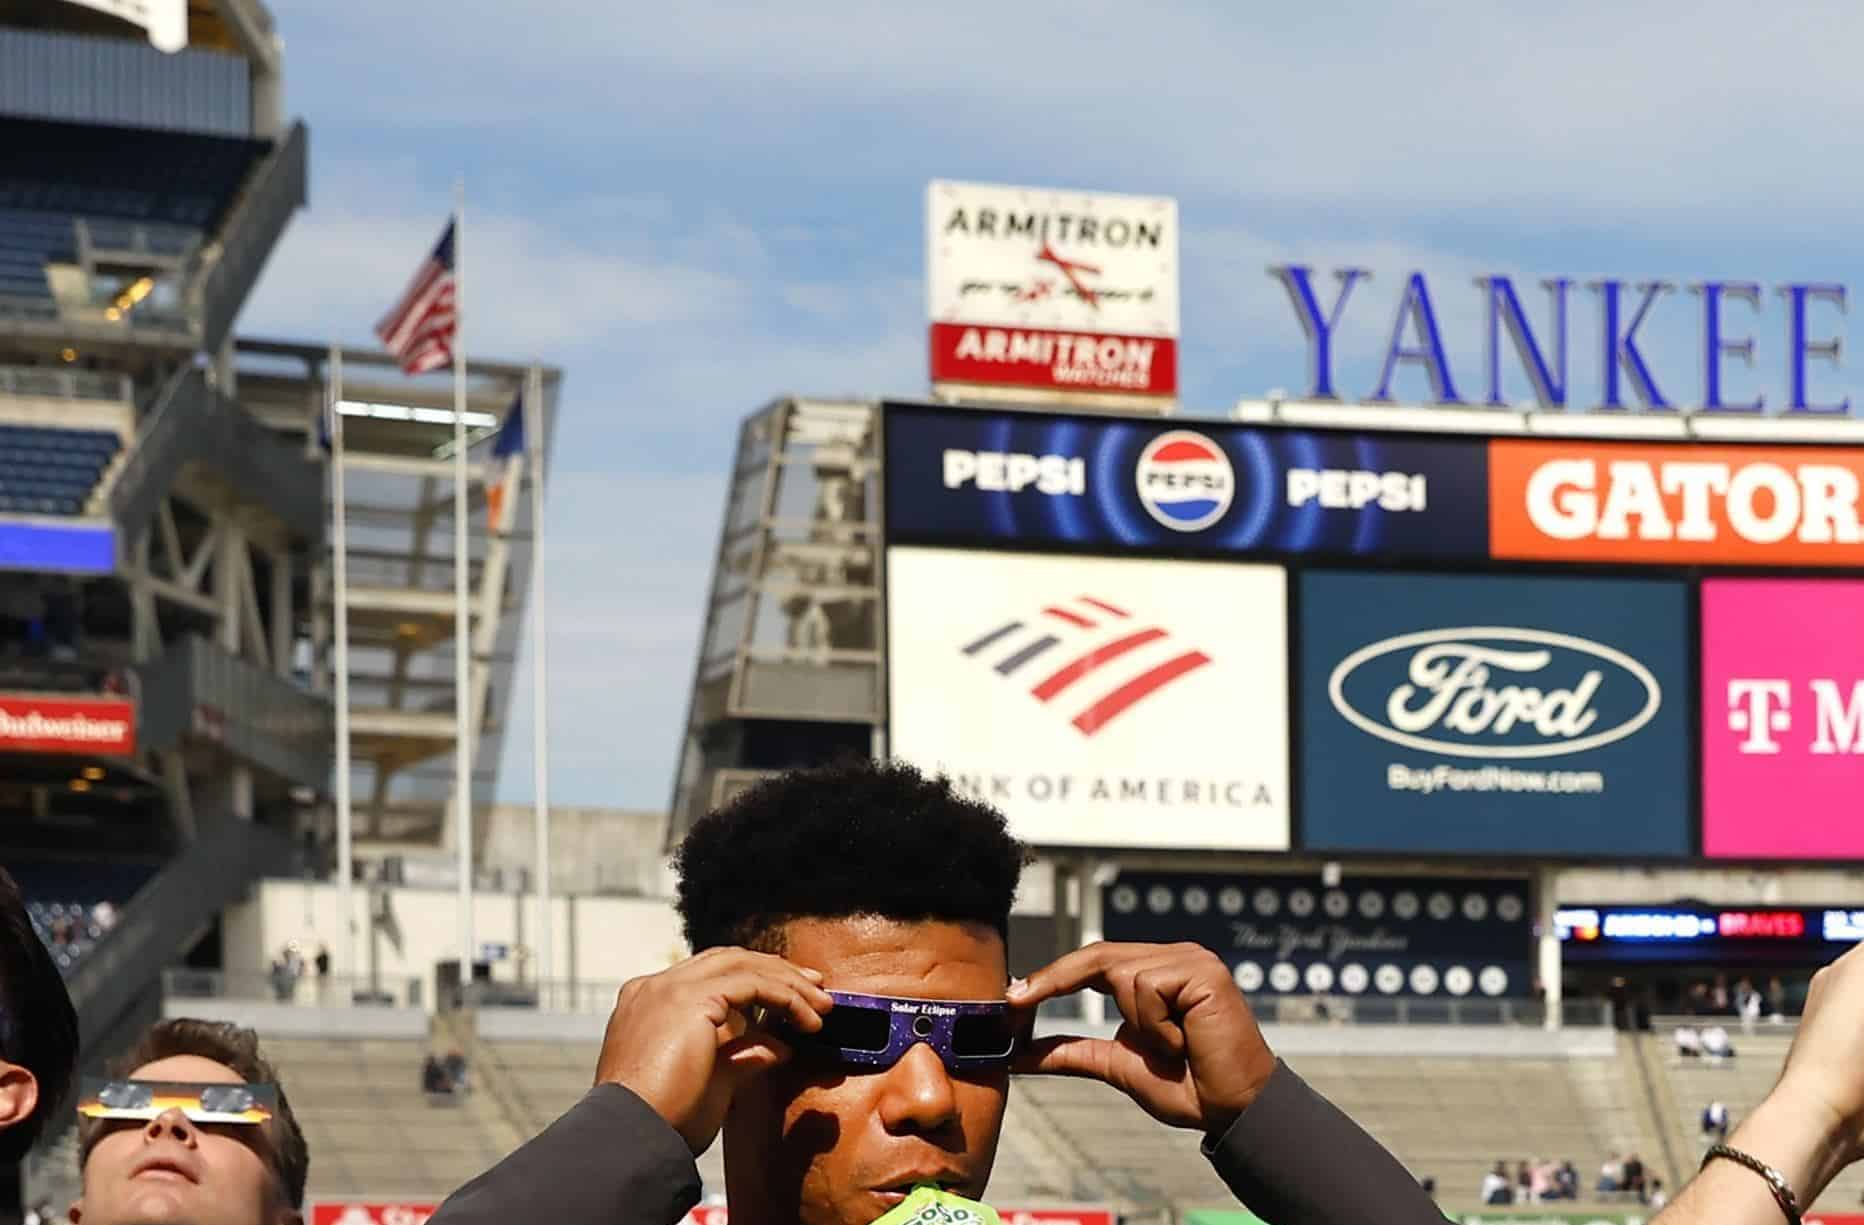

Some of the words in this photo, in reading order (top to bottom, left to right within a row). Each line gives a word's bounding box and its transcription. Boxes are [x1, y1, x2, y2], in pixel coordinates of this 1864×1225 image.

[946, 208, 1162, 247] ARMITRON
[955, 329, 1155, 370] ARMITRON
[1267, 264, 1849, 417] YANKEE
[943, 449, 1086, 495] PEPSI
[1146, 471, 1226, 491] PEPSI
[1287, 467, 1428, 512] PEPSI
[1387, 642, 1603, 738] Ford
[957, 773, 1012, 800] NK
[1026, 774, 1073, 801] OF
[1090, 777, 1274, 807] AMERICA
[1719, 911, 1806, 938] BRAVES
[890, 1002, 919, 1014] Solar
[920, 1003, 957, 1017] Eclipse
